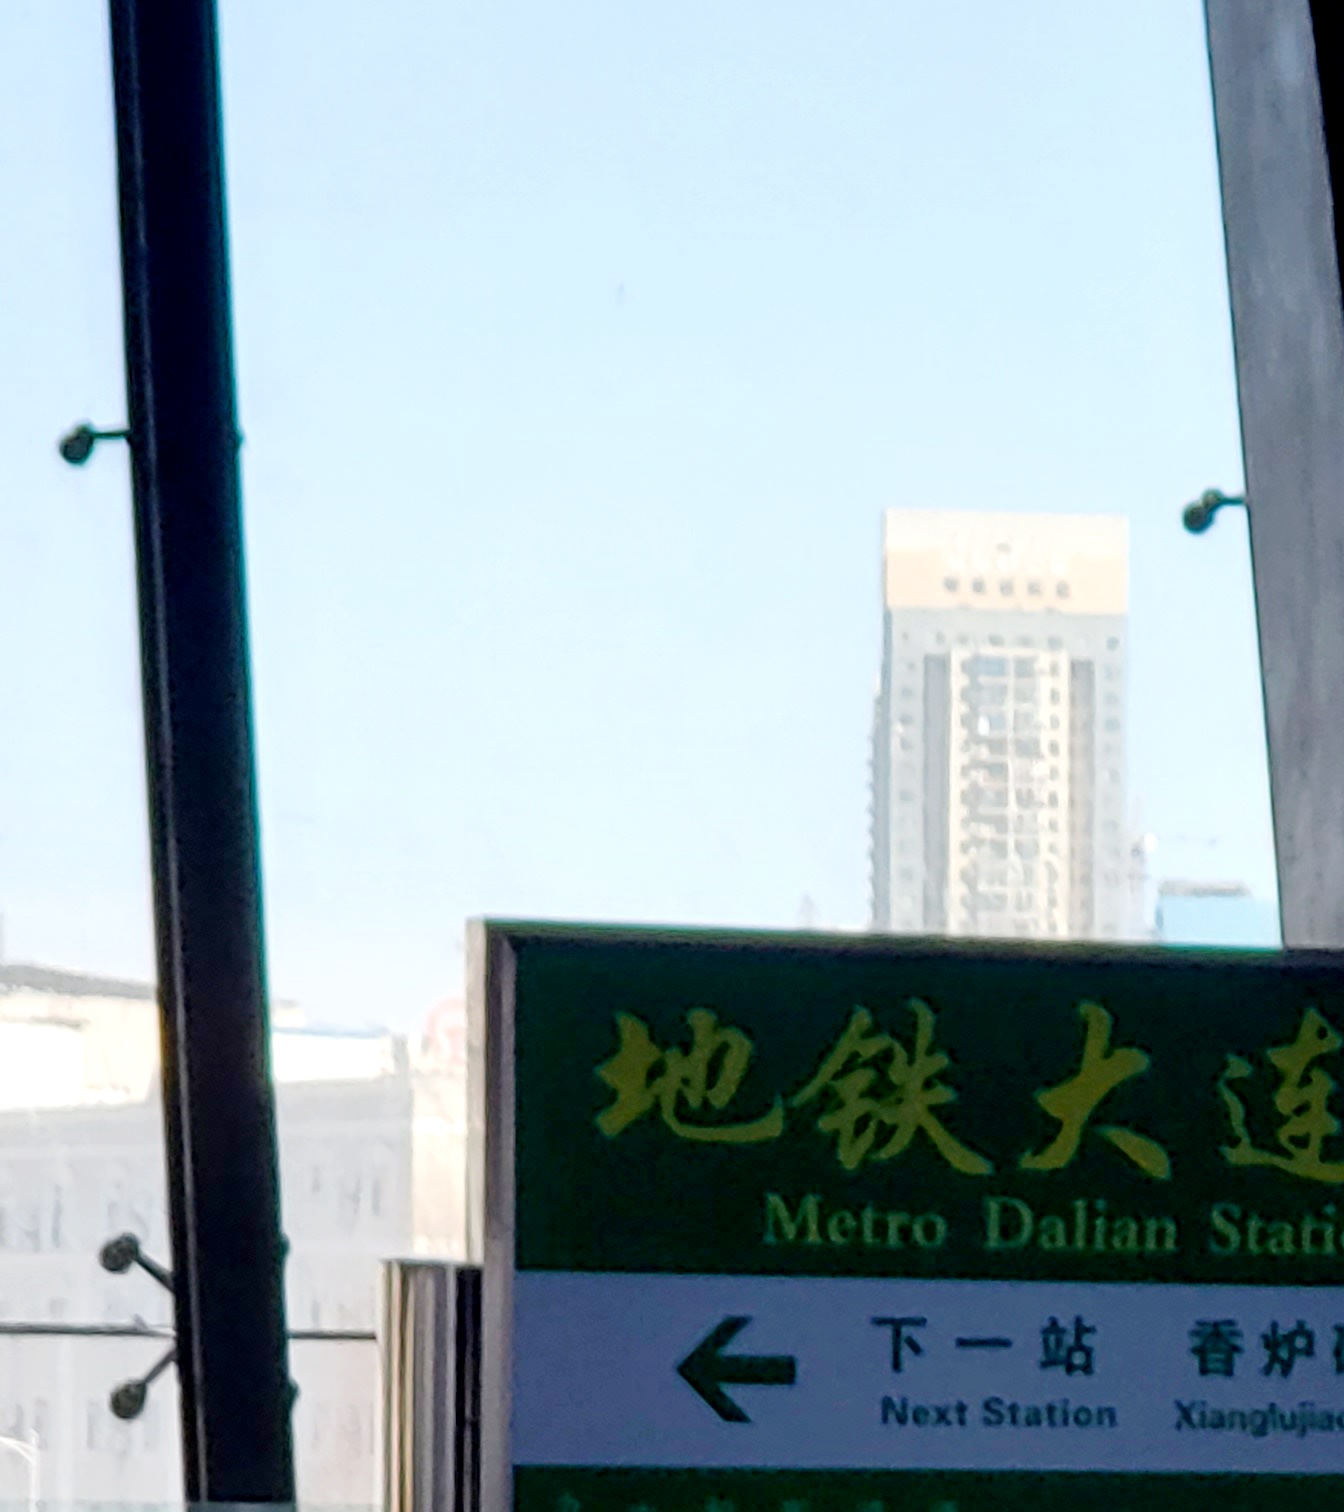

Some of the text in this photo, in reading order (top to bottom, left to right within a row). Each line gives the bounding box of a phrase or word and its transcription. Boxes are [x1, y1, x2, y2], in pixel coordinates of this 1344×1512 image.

[762, 1192, 949, 1248] Metro
[981, 1195, 1180, 1252] Dalian
[870, 1314, 1098, 1376] 下一站
[880, 1395, 969, 1428] Next
[981, 1396, 1118, 1429] Station
